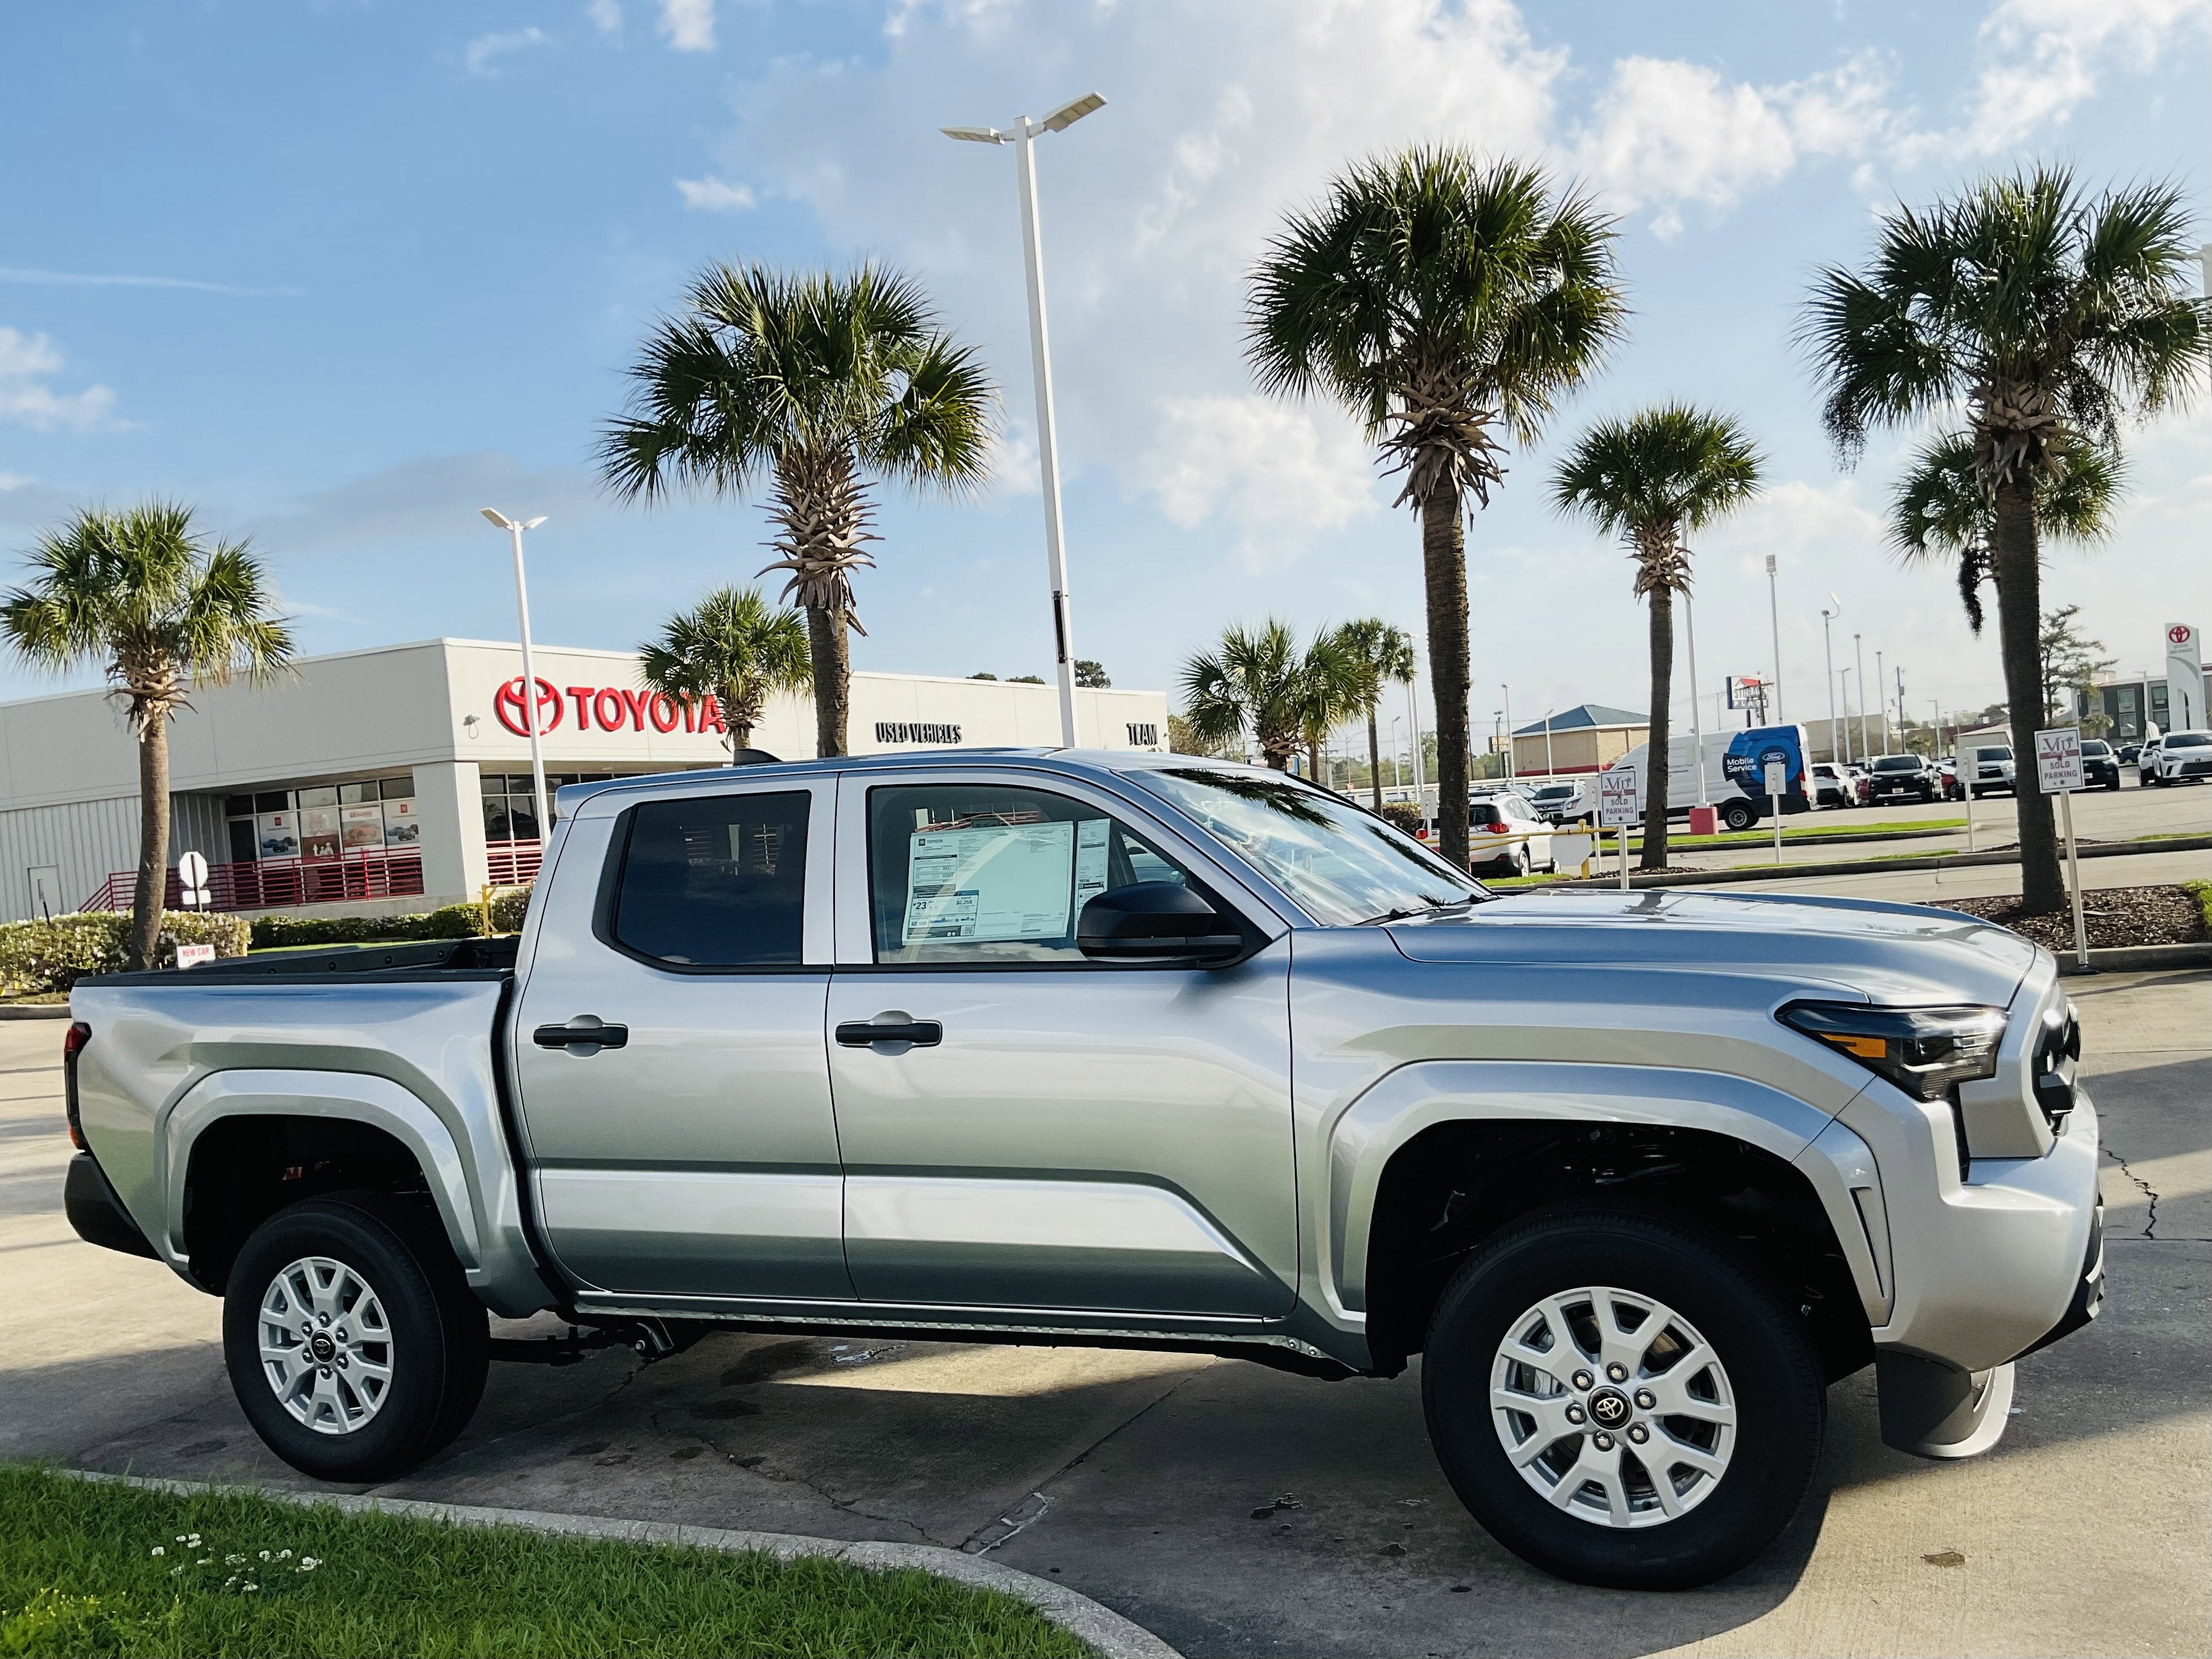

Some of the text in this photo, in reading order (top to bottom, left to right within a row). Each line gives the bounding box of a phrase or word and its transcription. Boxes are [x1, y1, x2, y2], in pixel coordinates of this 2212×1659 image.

[875, 722, 962, 744] USED VEHICLES
[1126, 723, 1158, 745] TEAM
[1727, 757, 1754, 765] Mobile
[2050, 761, 2070, 769] SOLD
[1727, 764, 1757, 773] Service
[2044, 770, 2078, 780] PARKING
[1606, 806, 1634, 815] PARKING
[915, 901, 927, 909] 23
[182, 946, 210, 957] NEW CAR
